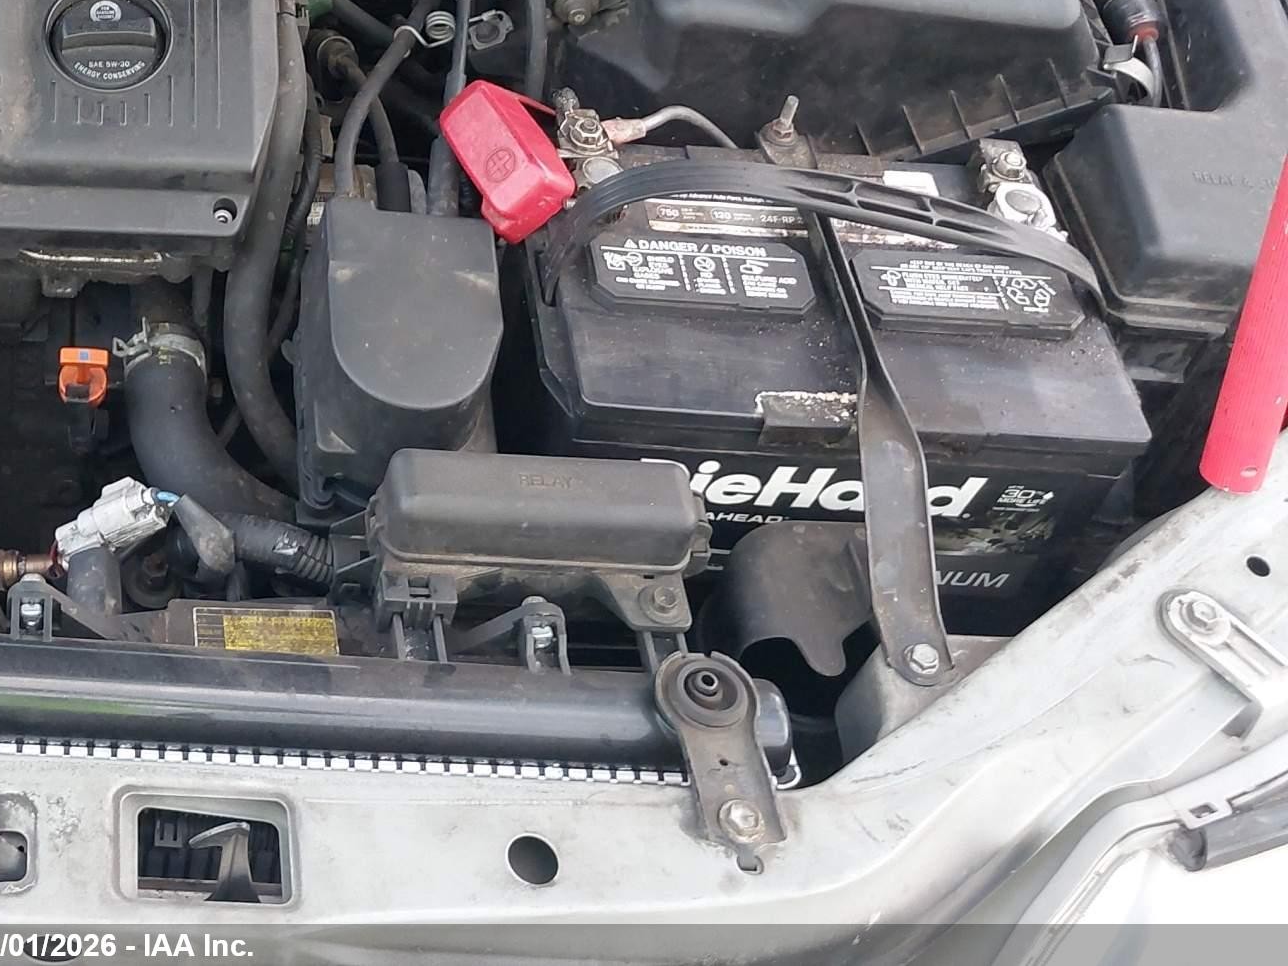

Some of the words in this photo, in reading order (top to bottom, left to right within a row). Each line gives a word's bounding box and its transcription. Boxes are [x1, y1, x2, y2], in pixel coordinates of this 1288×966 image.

[73, 62, 100, 79] ENERGY
[103, 60, 146, 80] CONSERVING
[88, 60, 103, 68] SAE
[106, 60, 130, 68] 5W-30
[638, 239, 698, 252] DANGER
[699, 243, 710, 253] /
[712, 244, 767, 257] POISON
[518, 474, 573, 489] RELAY
[640, 458, 988, 519] ieHad
